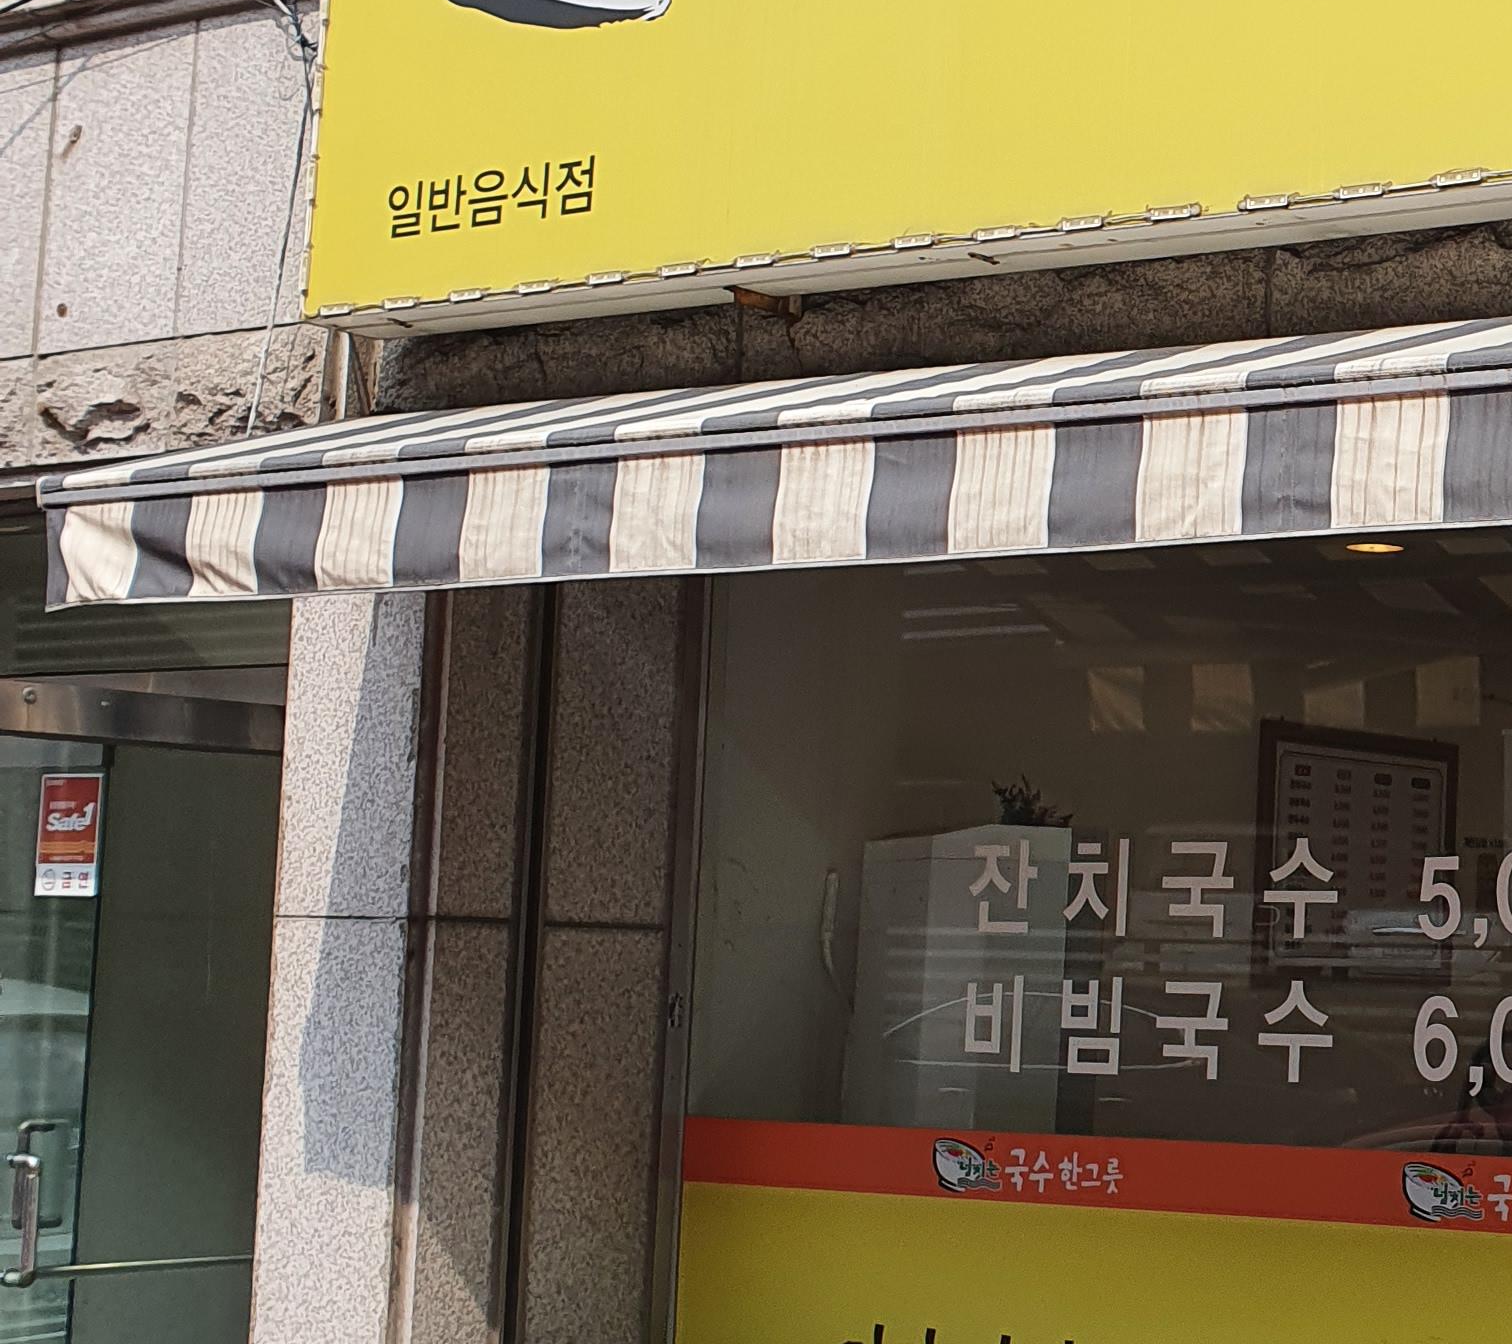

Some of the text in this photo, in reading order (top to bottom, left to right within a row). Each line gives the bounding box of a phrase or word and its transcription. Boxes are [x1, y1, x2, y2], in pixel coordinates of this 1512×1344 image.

[388, 155, 596, 239] 일반음식점
[969, 837, 1339, 940] 잔치국수
[964, 975, 1334, 1084] 비빔국수
[1005, 1148, 1054, 1193] 국수
[1058, 1151, 1124, 1195] 한그릇
